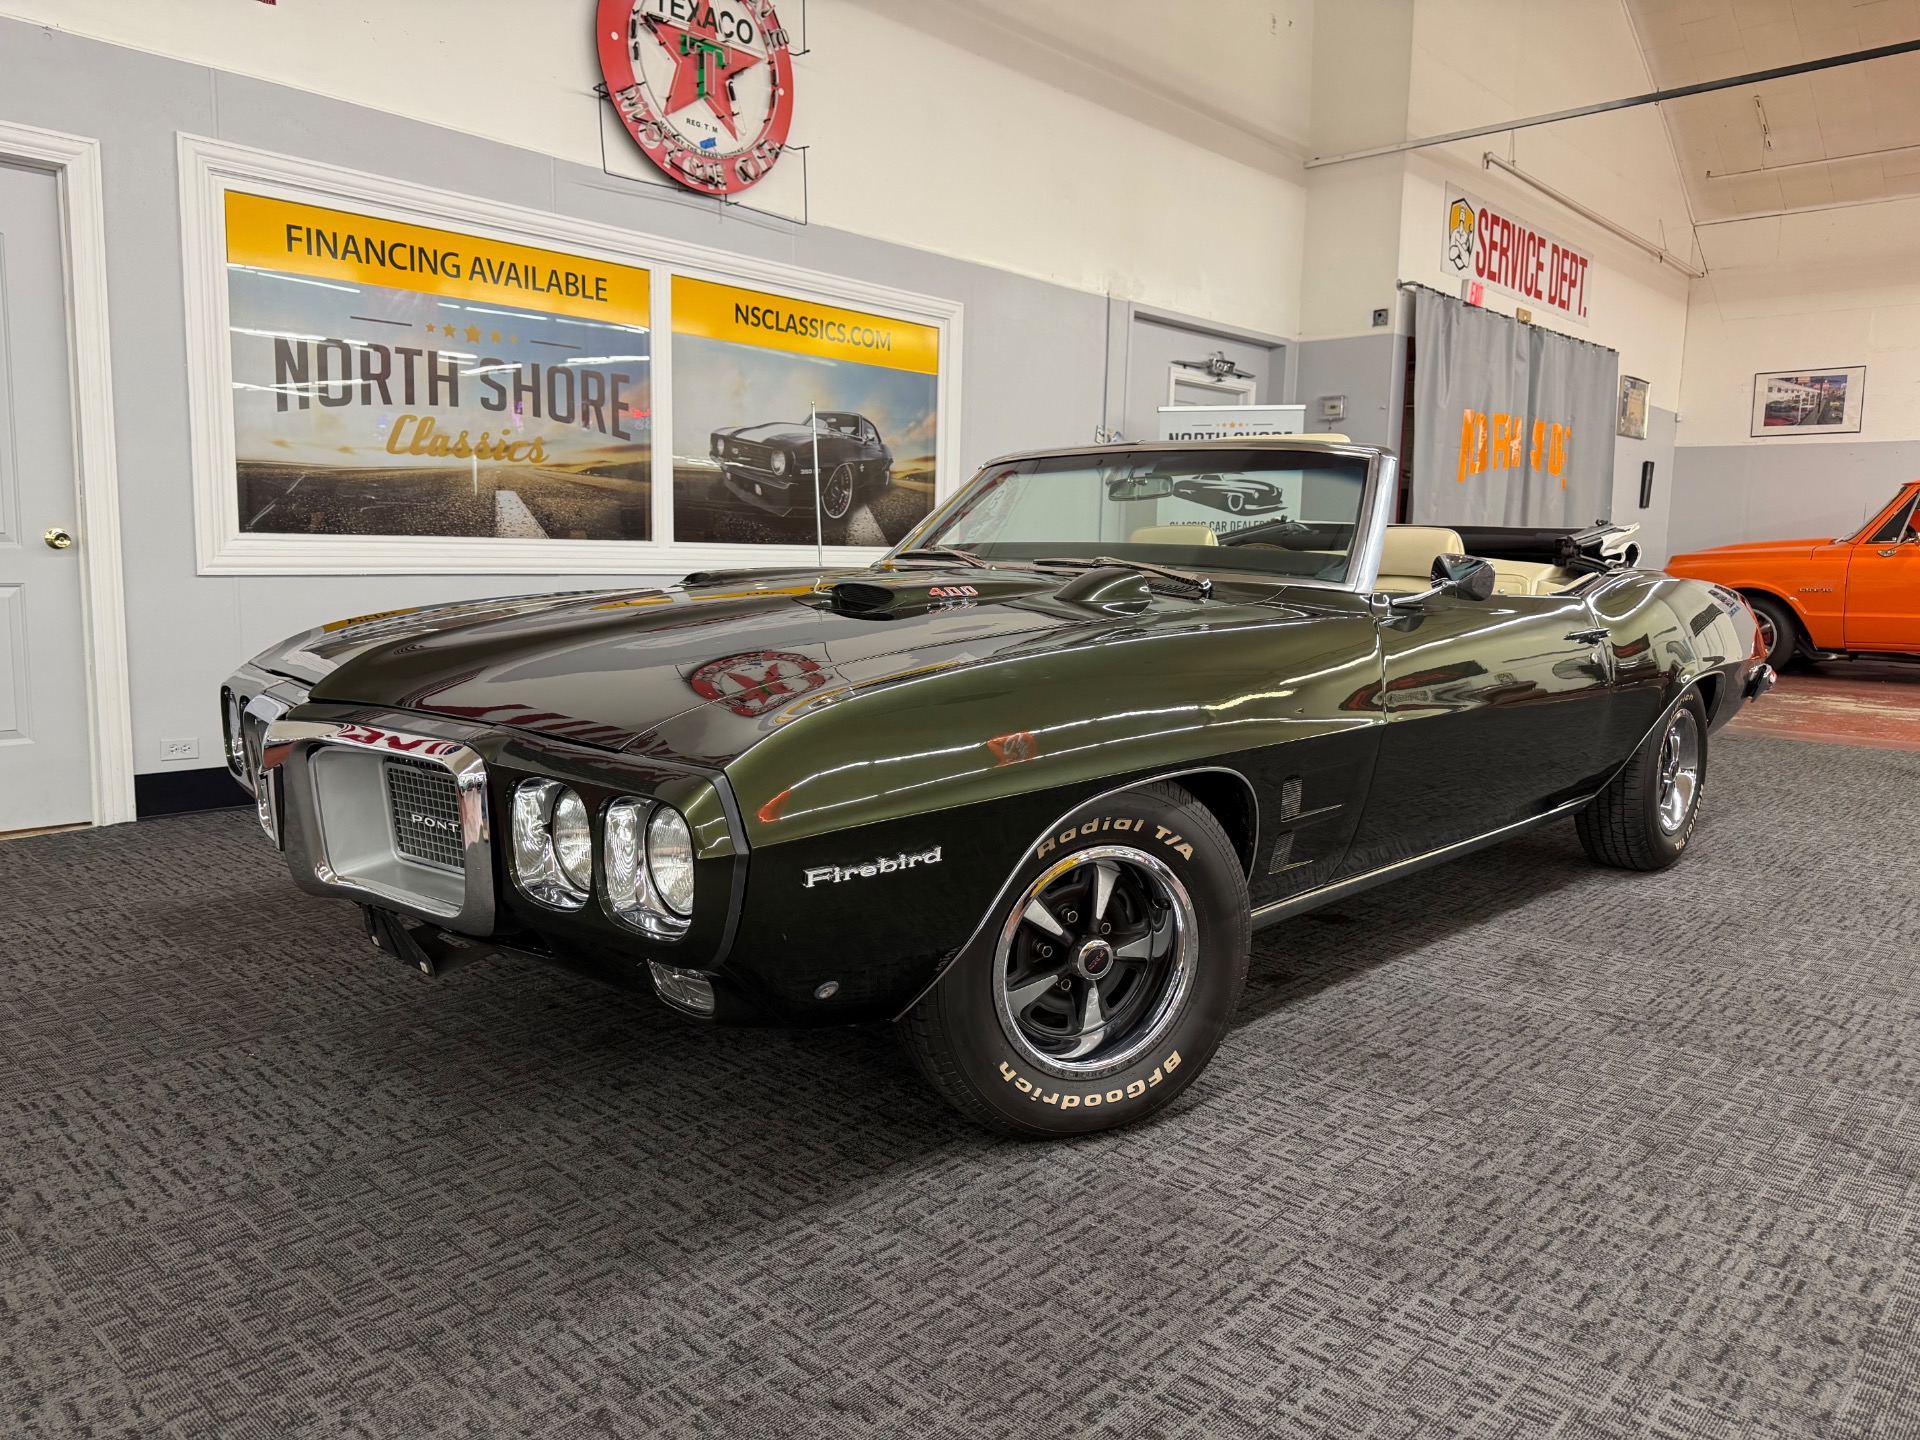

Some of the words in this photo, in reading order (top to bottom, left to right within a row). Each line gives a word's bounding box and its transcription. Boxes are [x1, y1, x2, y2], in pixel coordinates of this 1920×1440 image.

[286, 223, 461, 279] FINANCING
[468, 255, 608, 302] AVAILABLE
[1475, 207, 1546, 301] SERVICE
[1547, 242, 1589, 318] DEPT.
[735, 302, 891, 351] NSCLASSICS.COM
[273, 335, 460, 412] NORTH
[480, 357, 631, 442] SHORE
[385, 413, 550, 464] Classics
[1209, 520, 1228, 532] CAR
[928, 585, 979, 597] 400
[411, 813, 459, 833] PONT
[1036, 816, 1144, 860] Radial
[1154, 824, 1195, 861] T/A
[802, 845, 942, 888] Firebird
[998, 1050, 1183, 1110] BFGoodrich
